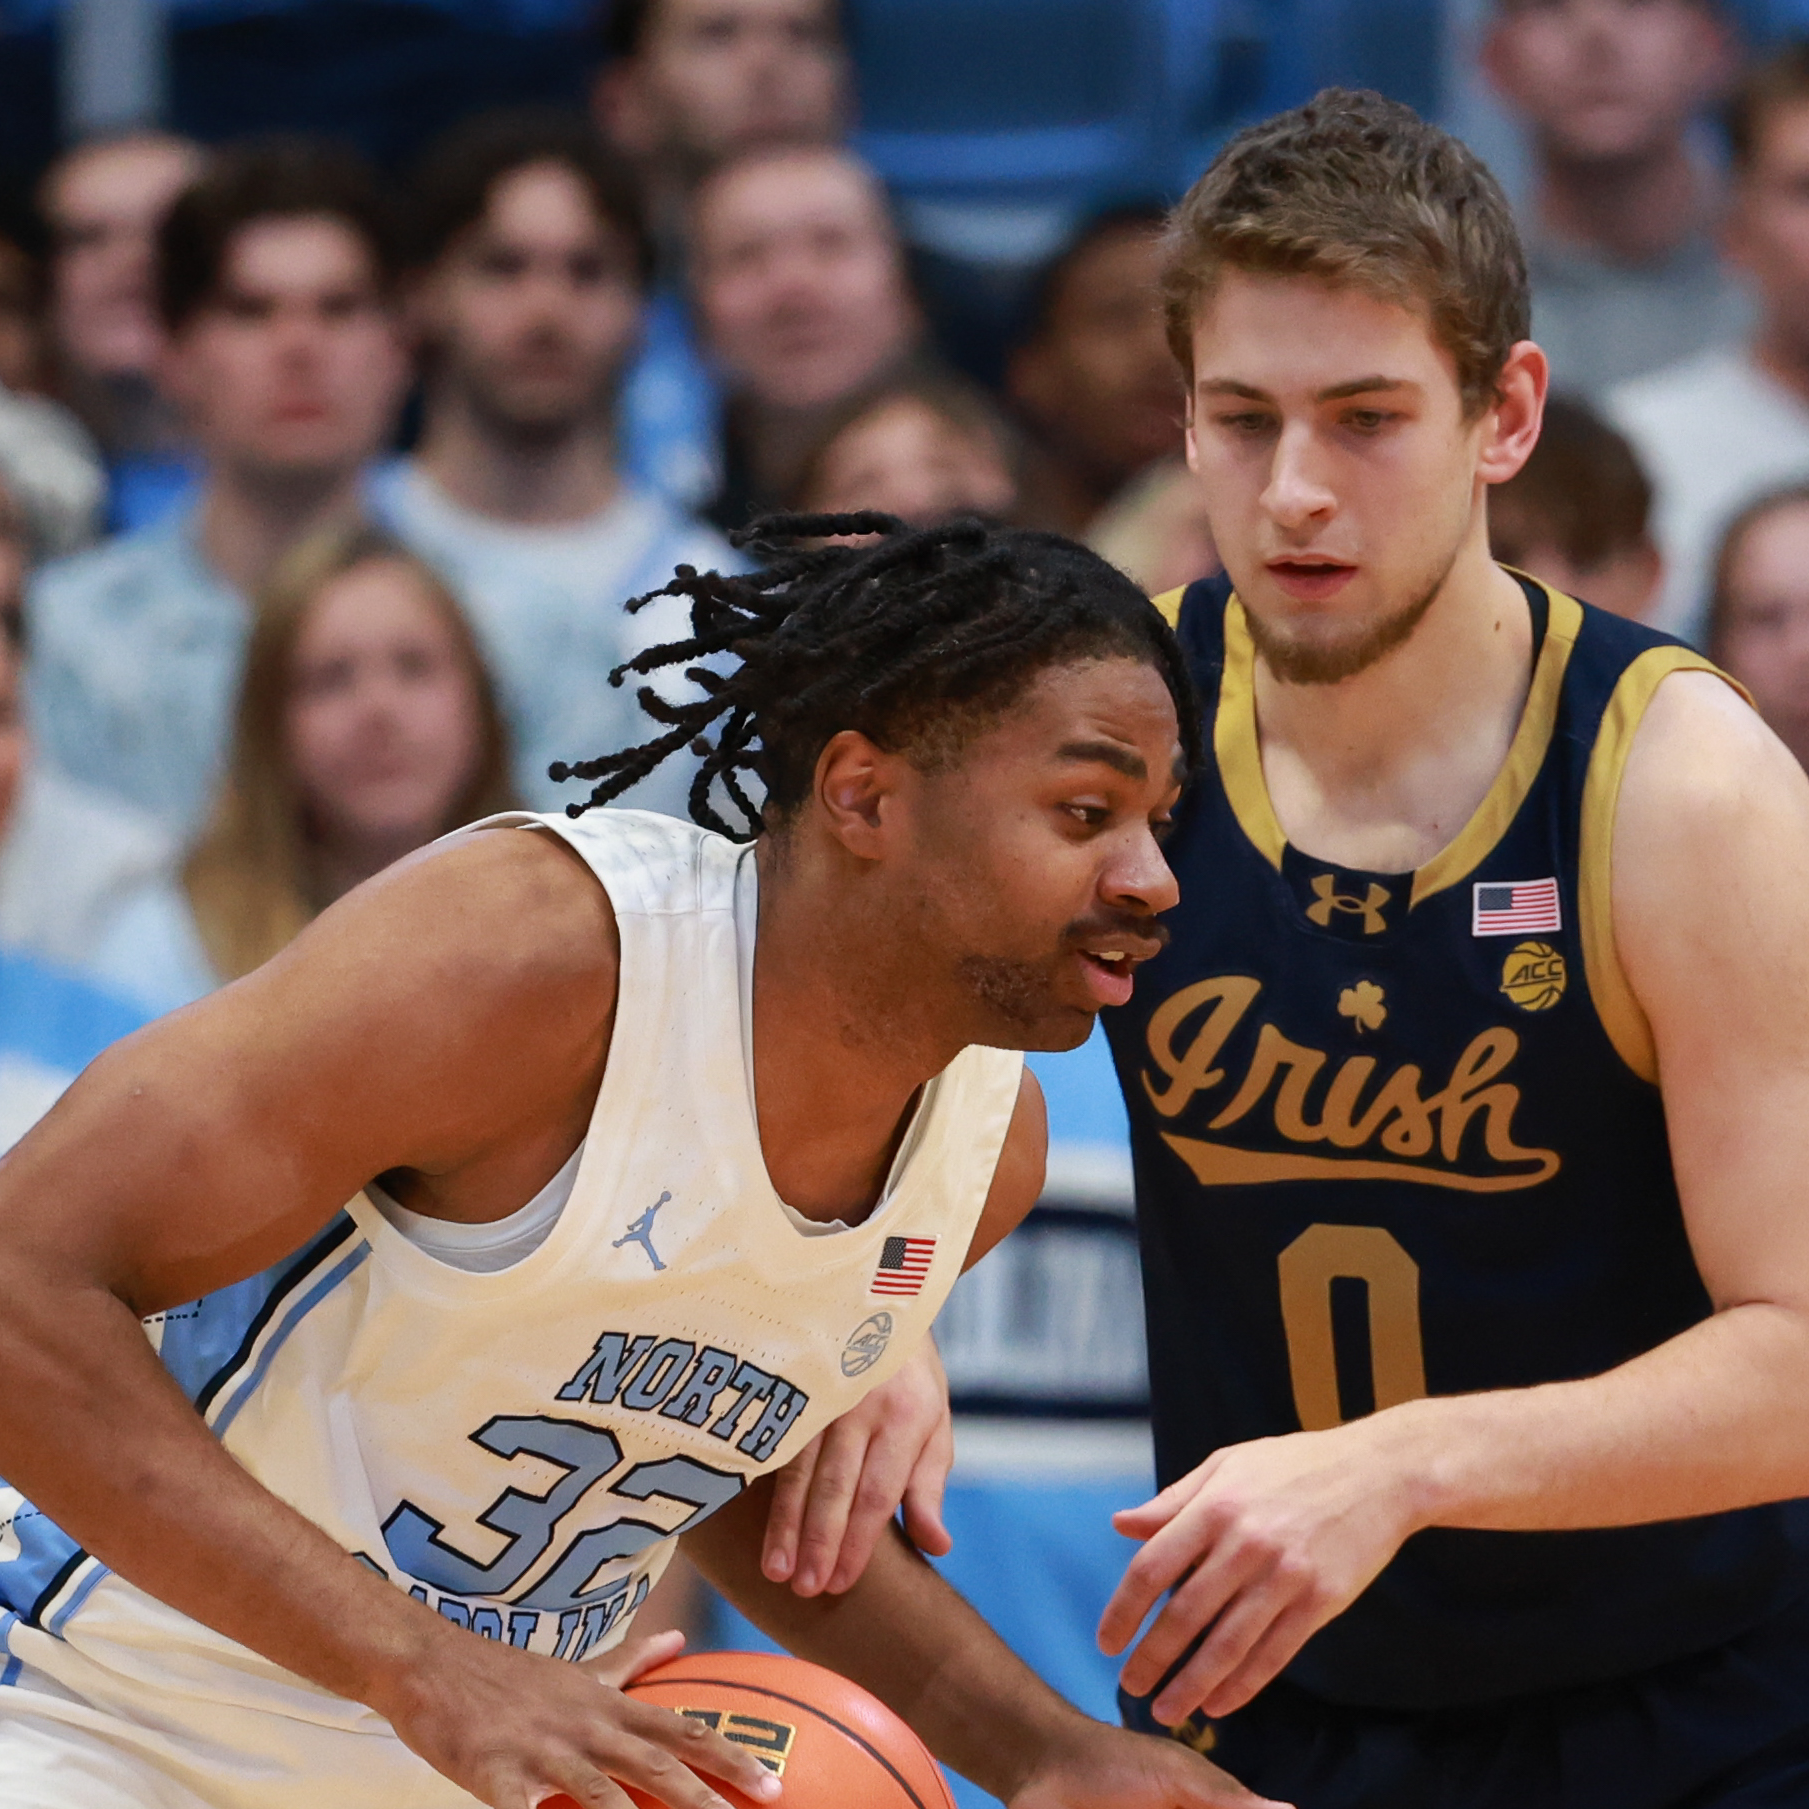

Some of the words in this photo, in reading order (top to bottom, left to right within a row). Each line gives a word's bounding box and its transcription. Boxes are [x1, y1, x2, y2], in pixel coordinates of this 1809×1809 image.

[1509, 958, 1564, 983] ACC
[1141, 976, 1561, 1172] Irish
[555, 1331, 810, 1463] NORTH
[1278, 1223, 1426, 1431] 0
[380, 1414, 750, 1612] 32
